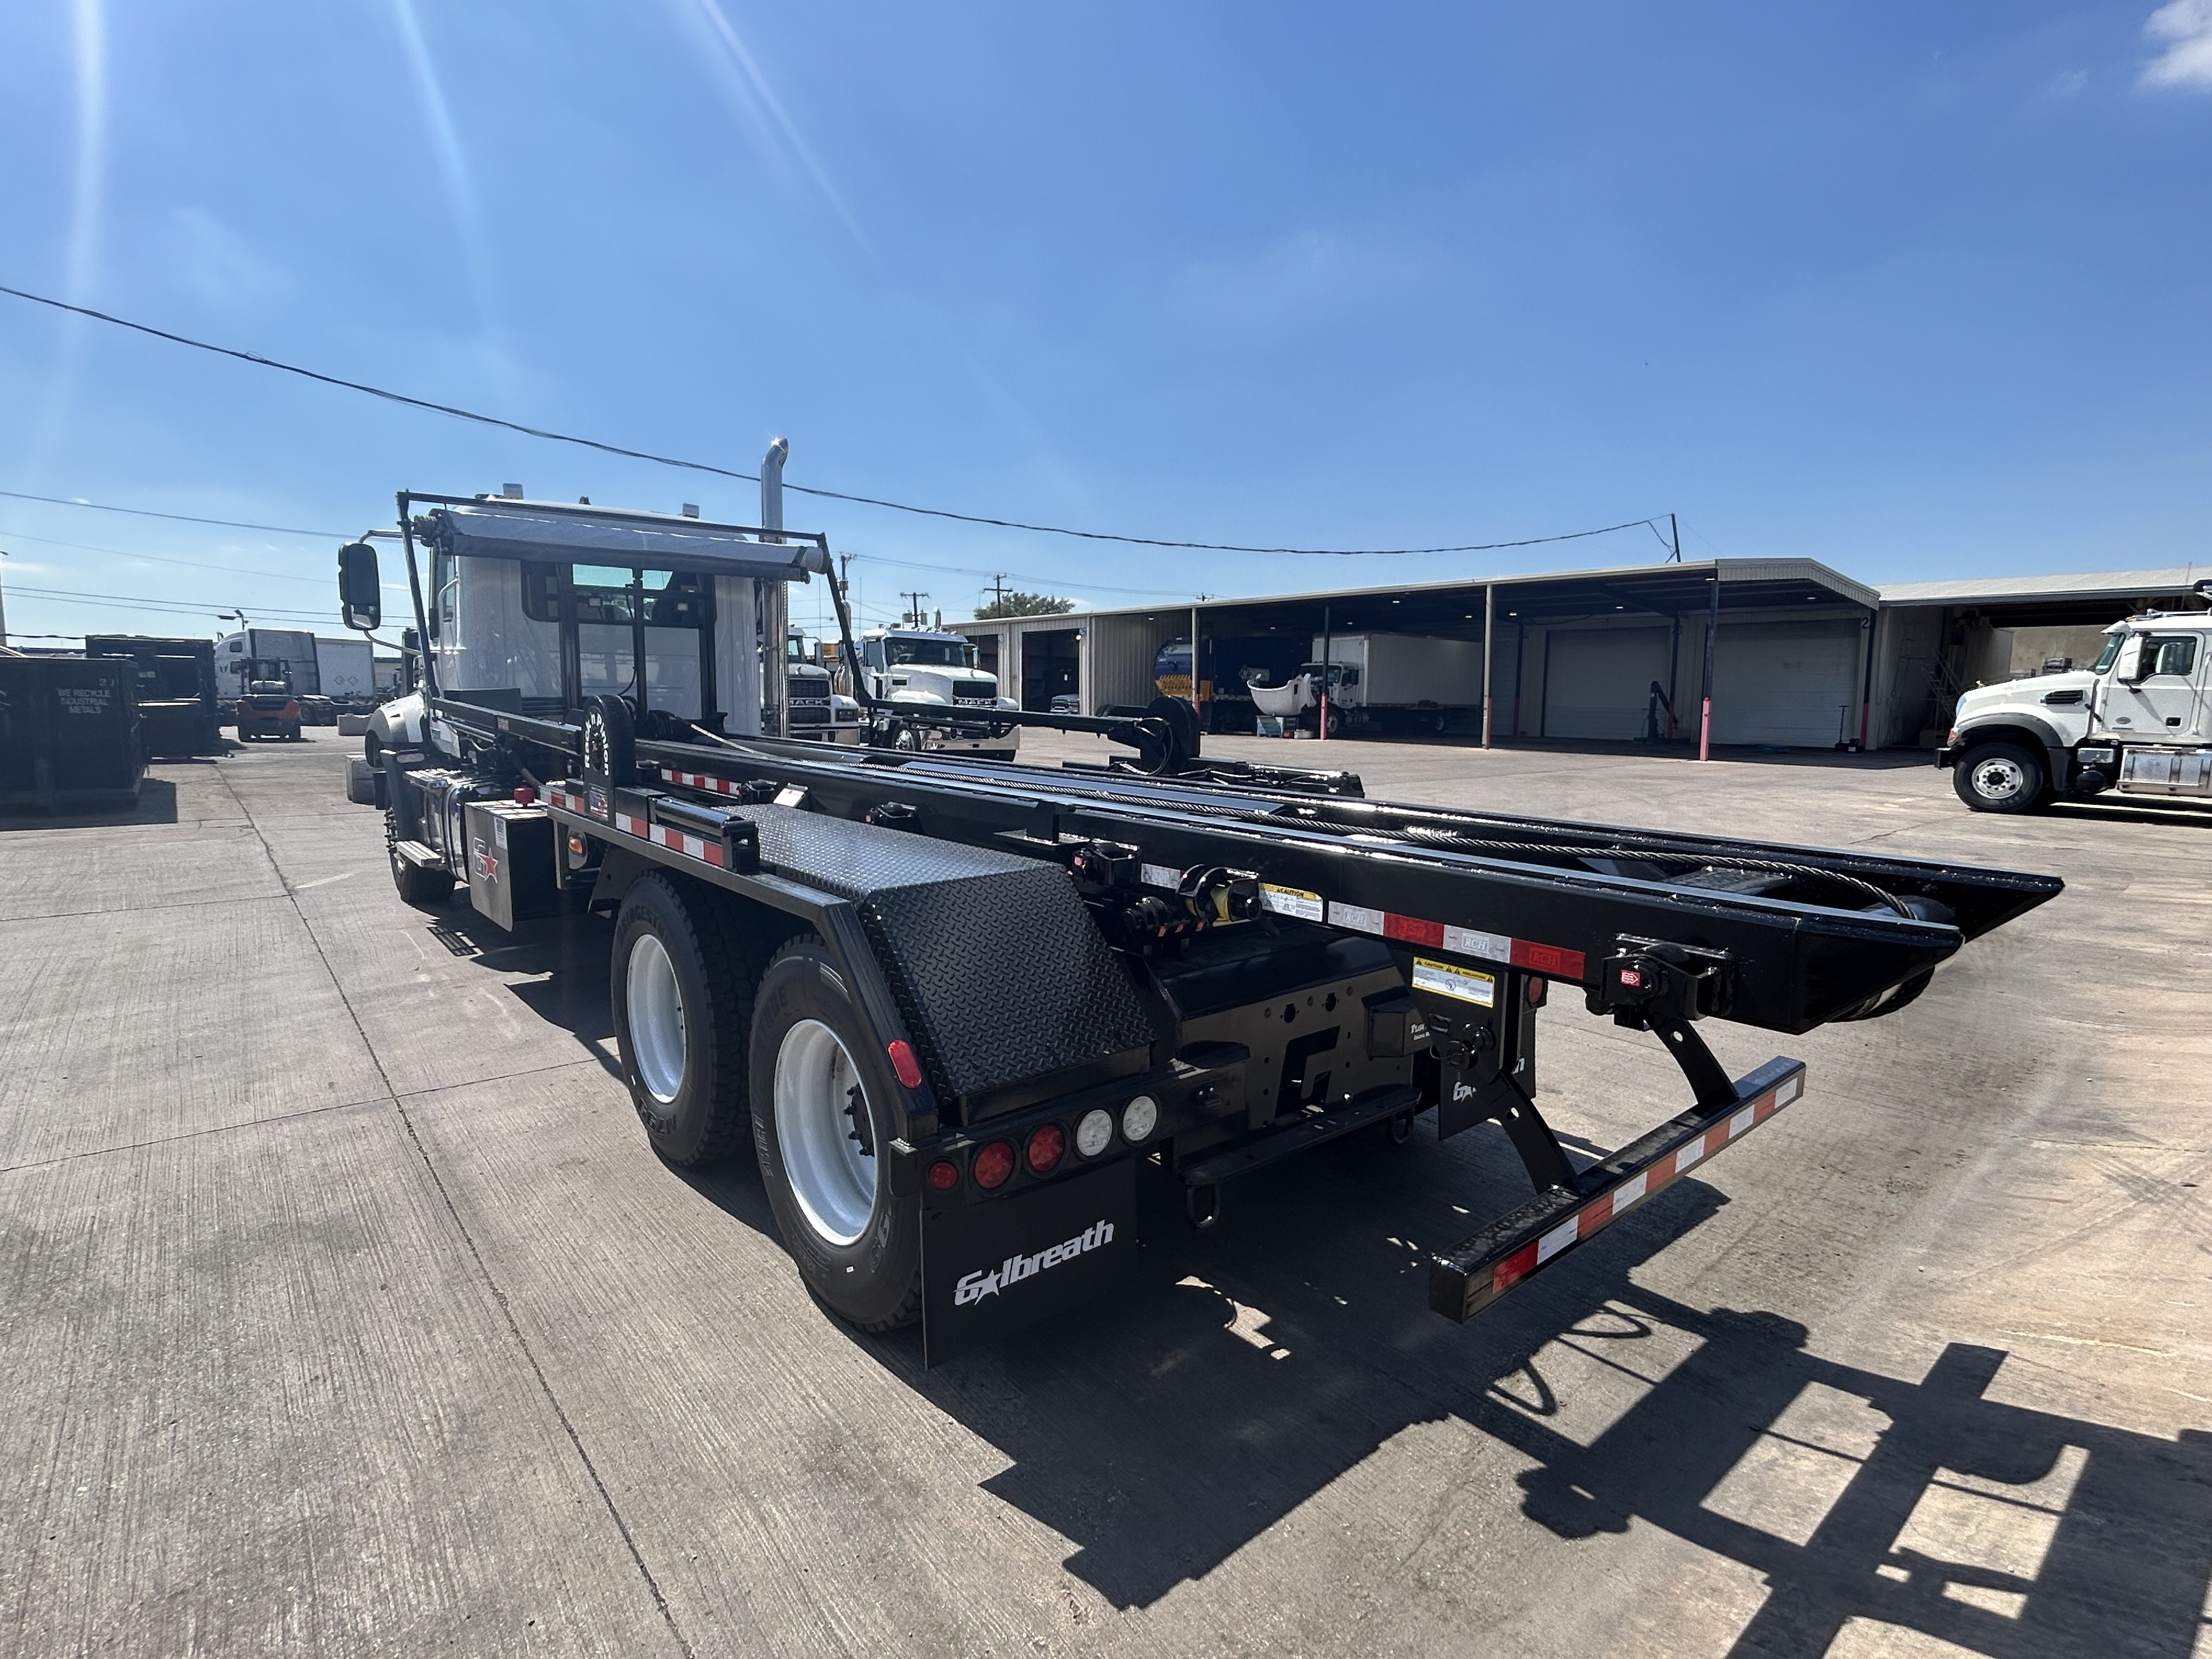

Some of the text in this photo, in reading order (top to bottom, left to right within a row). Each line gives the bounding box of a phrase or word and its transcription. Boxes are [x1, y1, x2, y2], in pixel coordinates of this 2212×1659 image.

[73, 689, 110, 697] RECYCLE
[60, 697, 109, 706] INDUSTRIAL
[596, 713, 610, 776] Pinion
[1465, 938, 1487, 950] RCH
